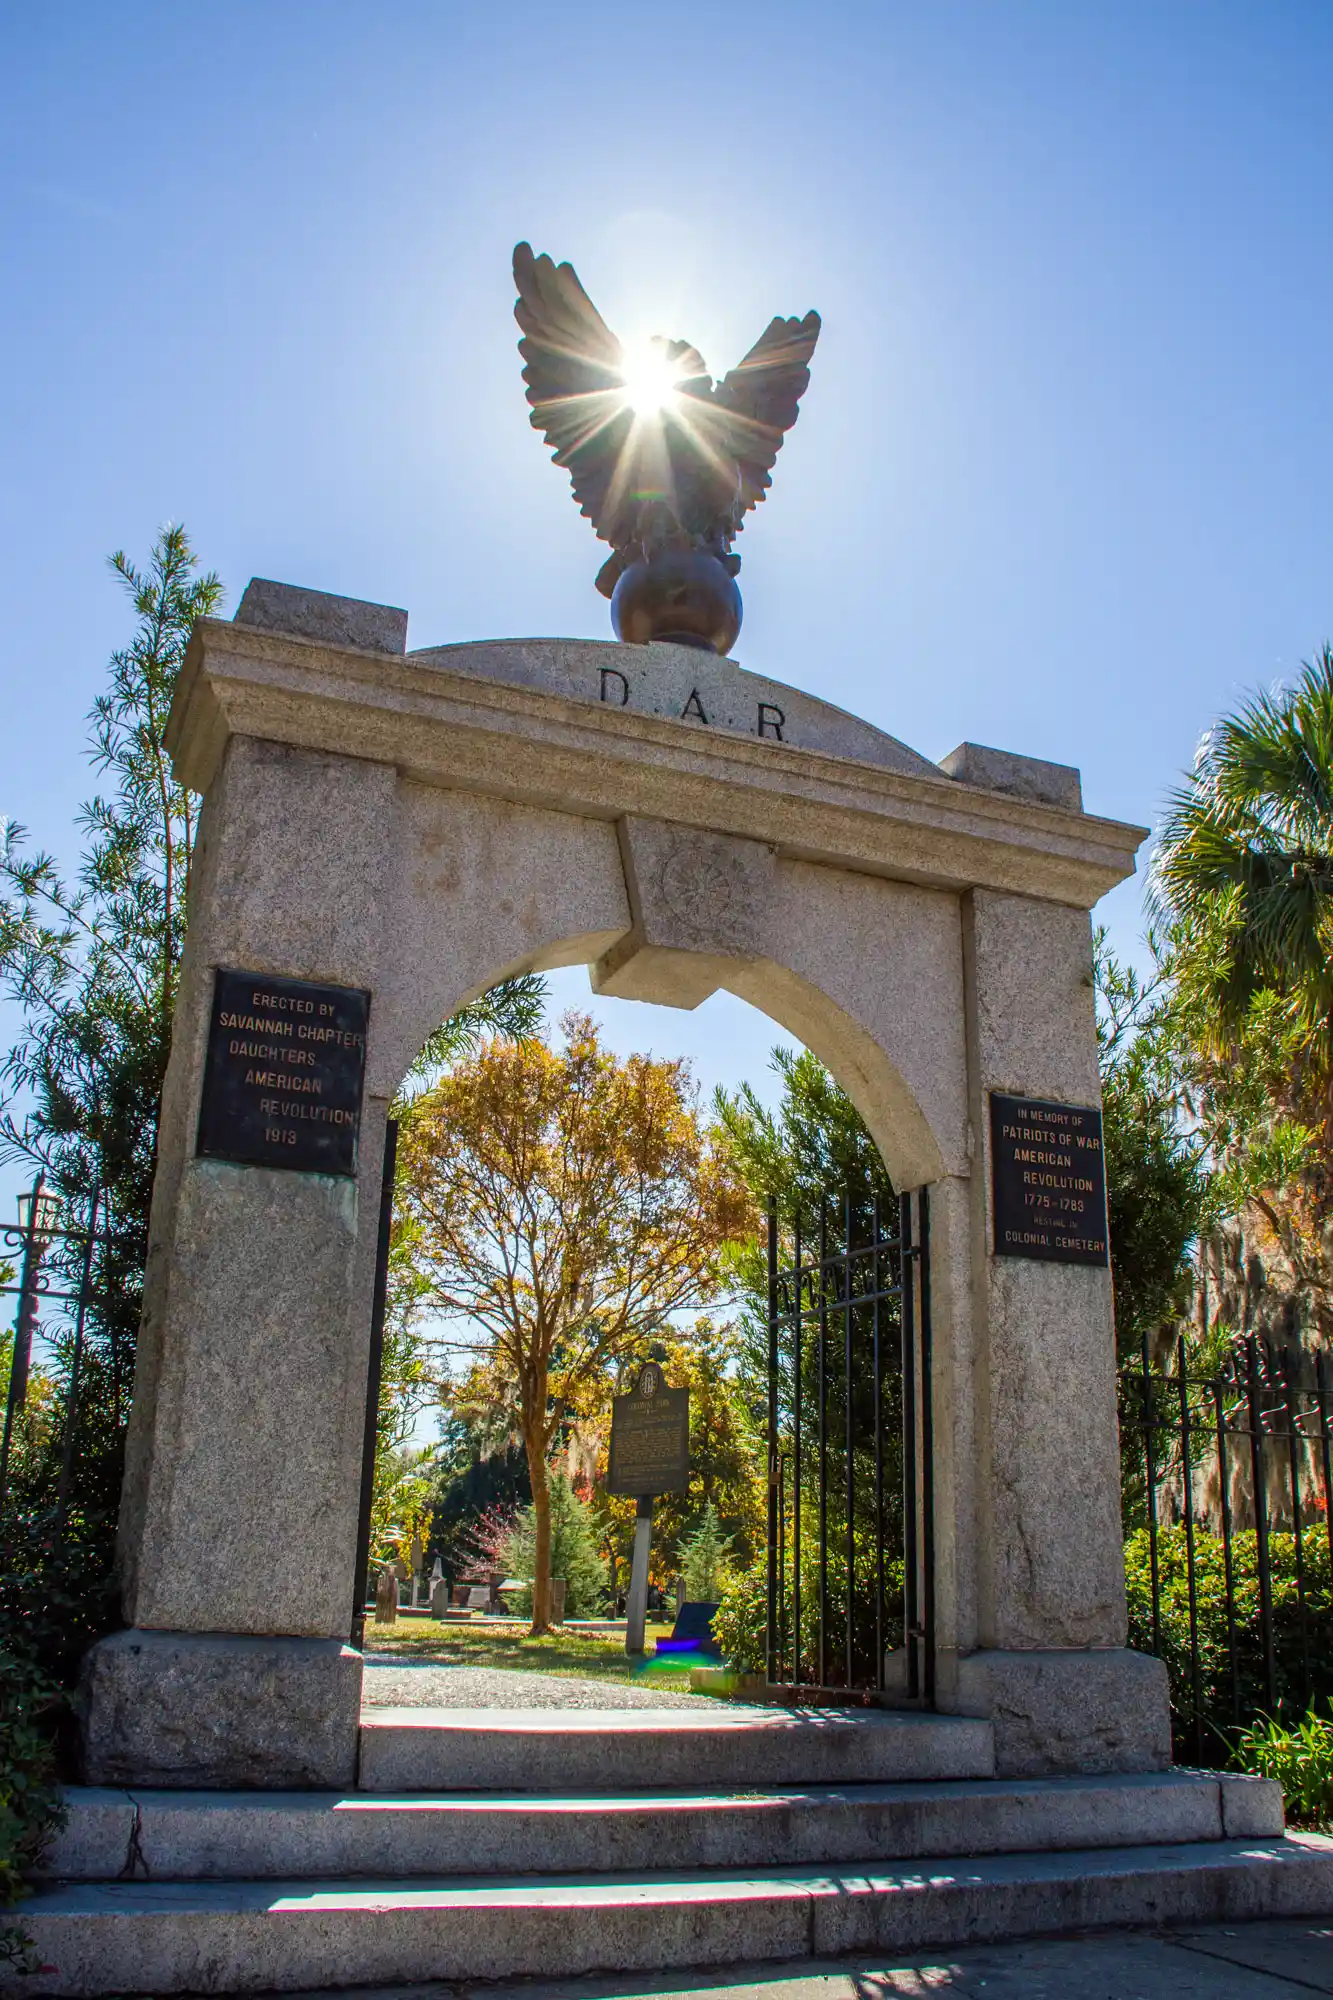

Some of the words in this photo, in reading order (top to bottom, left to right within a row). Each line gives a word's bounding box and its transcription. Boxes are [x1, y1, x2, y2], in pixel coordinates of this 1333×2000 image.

[252, 992, 314, 1013] ERECTED
[319, 1003, 336, 1017] BY
[219, 1012, 293, 1037] SAVANNAH
[297, 1025, 363, 1047] CHAPTER
[229, 1040, 316, 1066] DAUGHTERS
[244, 1069, 322, 1095] AMERICAN
[260, 1098, 355, 1125] REVOLUTION
[1017, 1108, 1027, 1119] IN
[1030, 1110, 1068, 1125] MEMORY
[1071, 1115, 1083, 1126] OF
[264, 1128, 297, 1145] 1913
[1002, 1125, 1056, 1144] PATRIOTS
[1058, 1133, 1072, 1146] OF
[1076, 1136, 1100, 1150] WAR
[1013, 1147, 1071, 1167] AMERICAN
[1023, 1171, 1093, 1192] REVOLUTION
[1005, 1230, 1051, 1247] COLONIAL
[1055, 1236, 1105, 1253] CEMETERY
